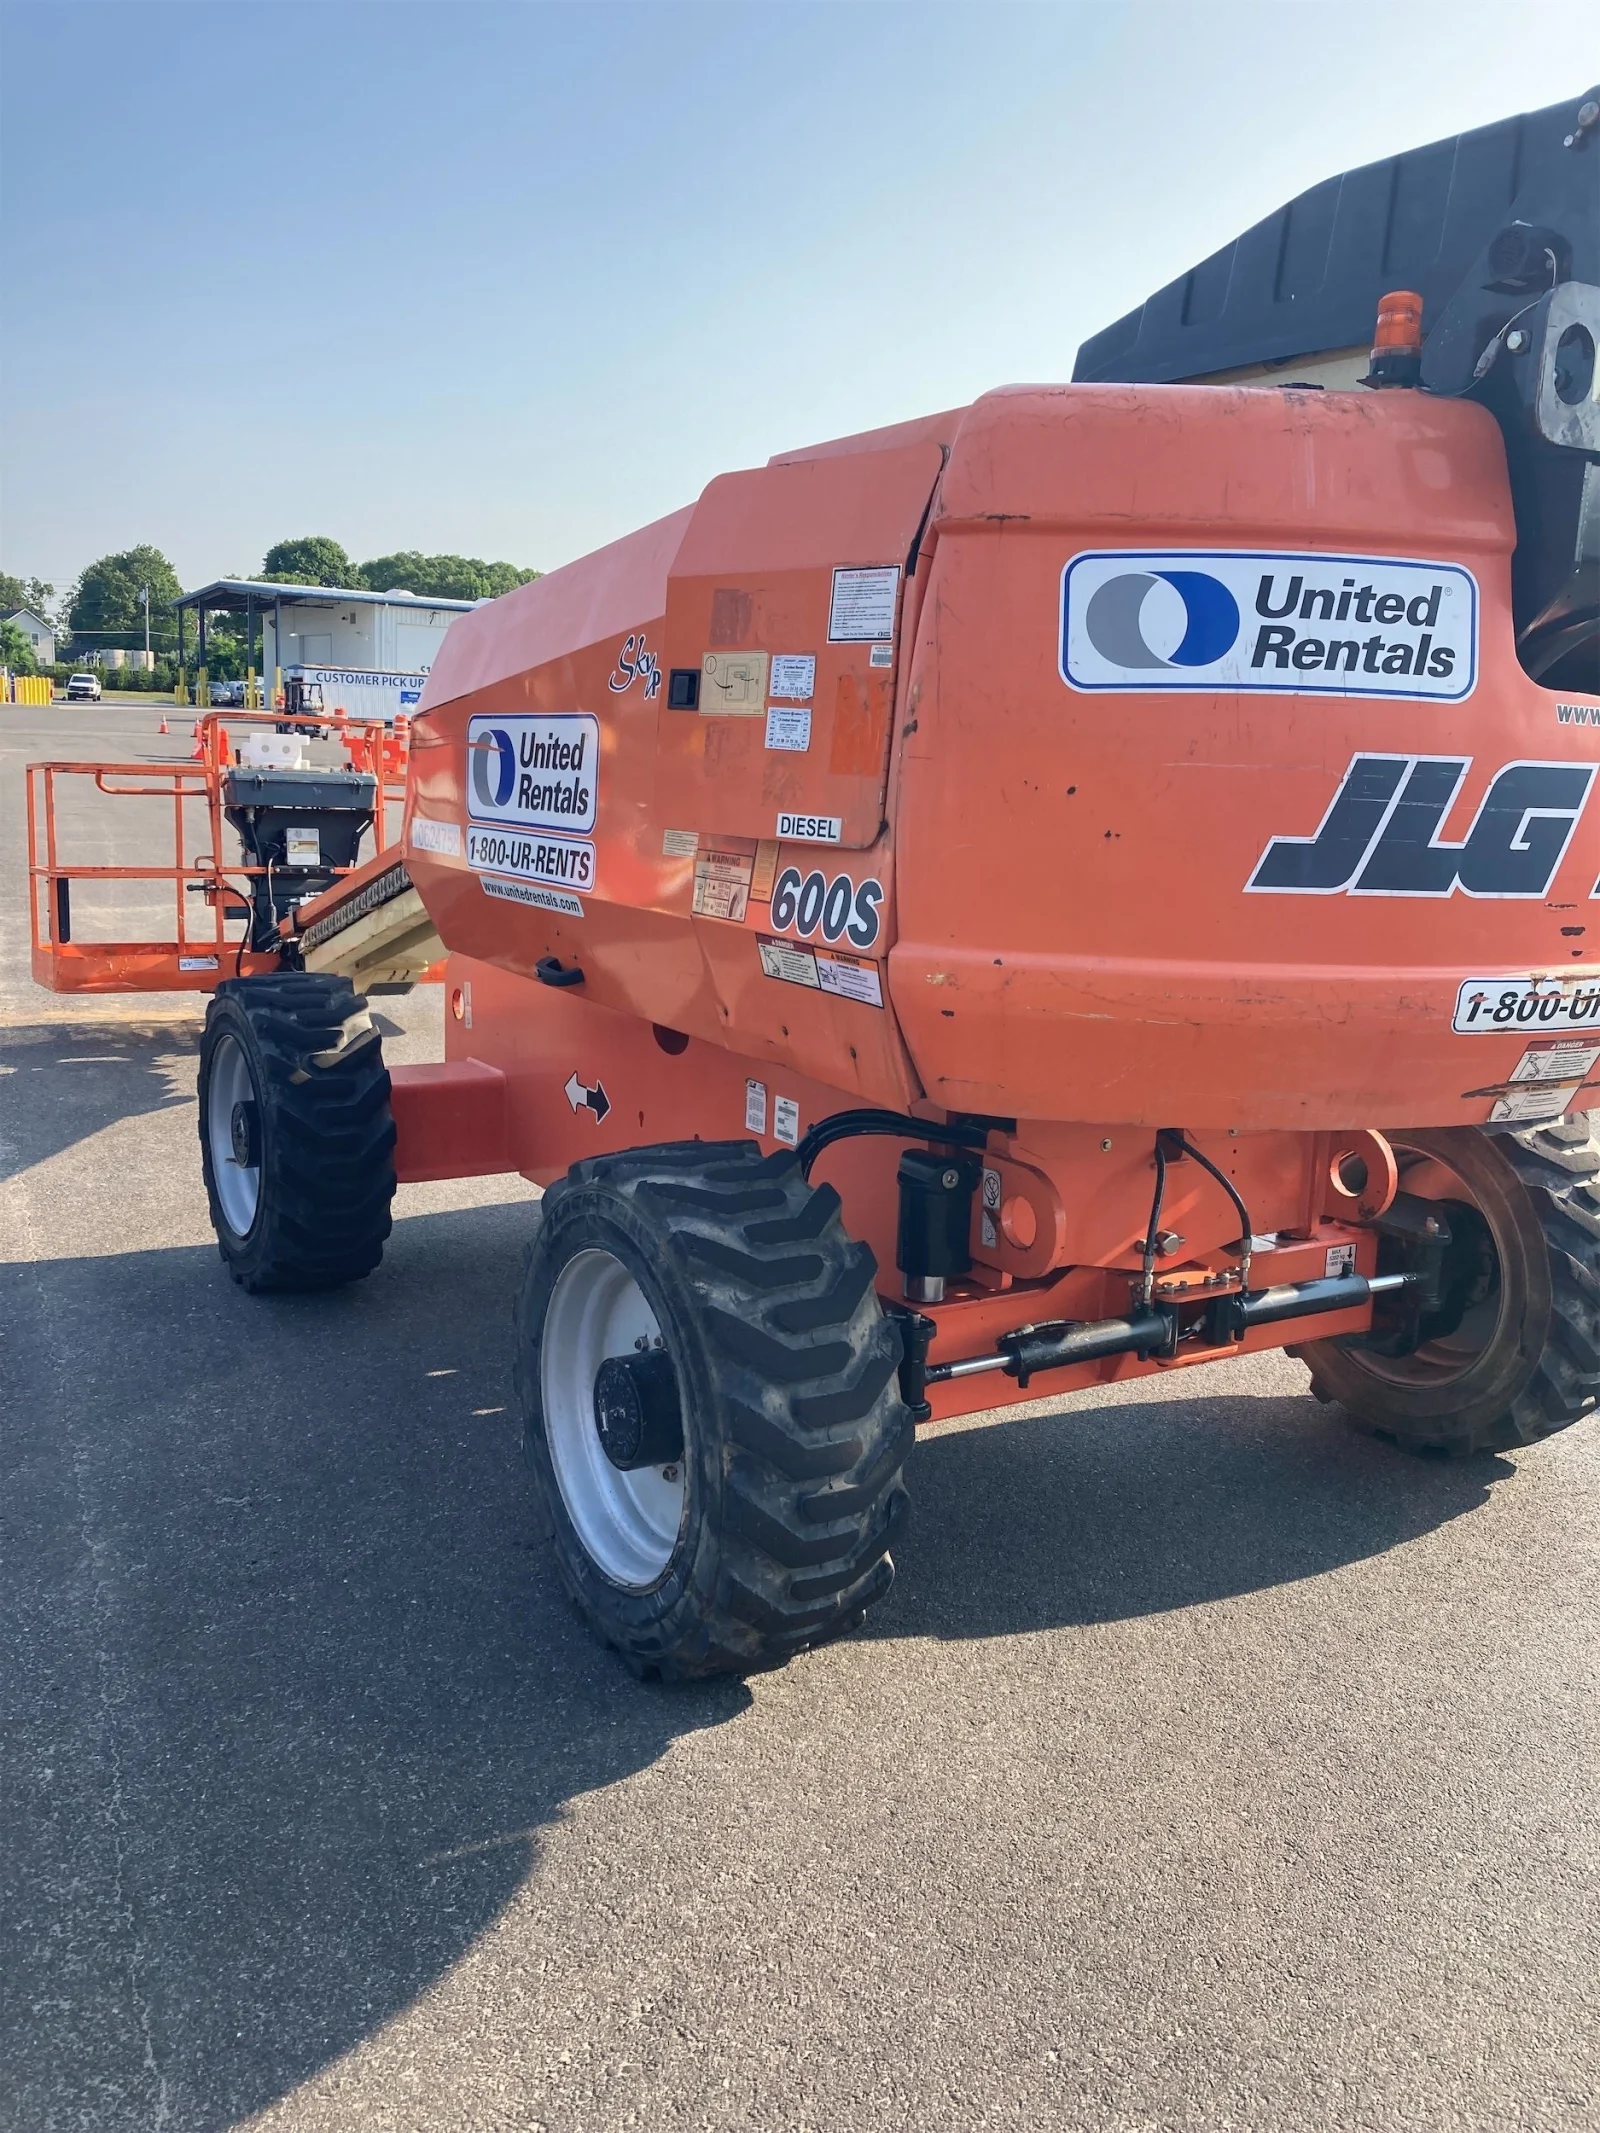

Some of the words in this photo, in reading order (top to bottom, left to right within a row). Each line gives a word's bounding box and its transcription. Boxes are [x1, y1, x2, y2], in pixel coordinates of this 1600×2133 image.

[1254, 574, 1443, 628] United
[1250, 624, 1457, 679] Rentals
[316, 672, 379, 686] CUSTOMER
[382, 676, 407, 688] PICK
[409, 678, 425, 688] UP
[519, 731, 586, 771] United
[517, 773, 589, 816] Rentals
[780, 816, 838, 839] DIESEL
[1243, 752, 1599, 899] JLG
[469, 836, 591, 881] 1-800-UR-RENTS
[711, 854, 741, 867] WARNING
[483, 881, 581, 914] www.unitedrentals.com
[770, 866, 884, 949] 600S
